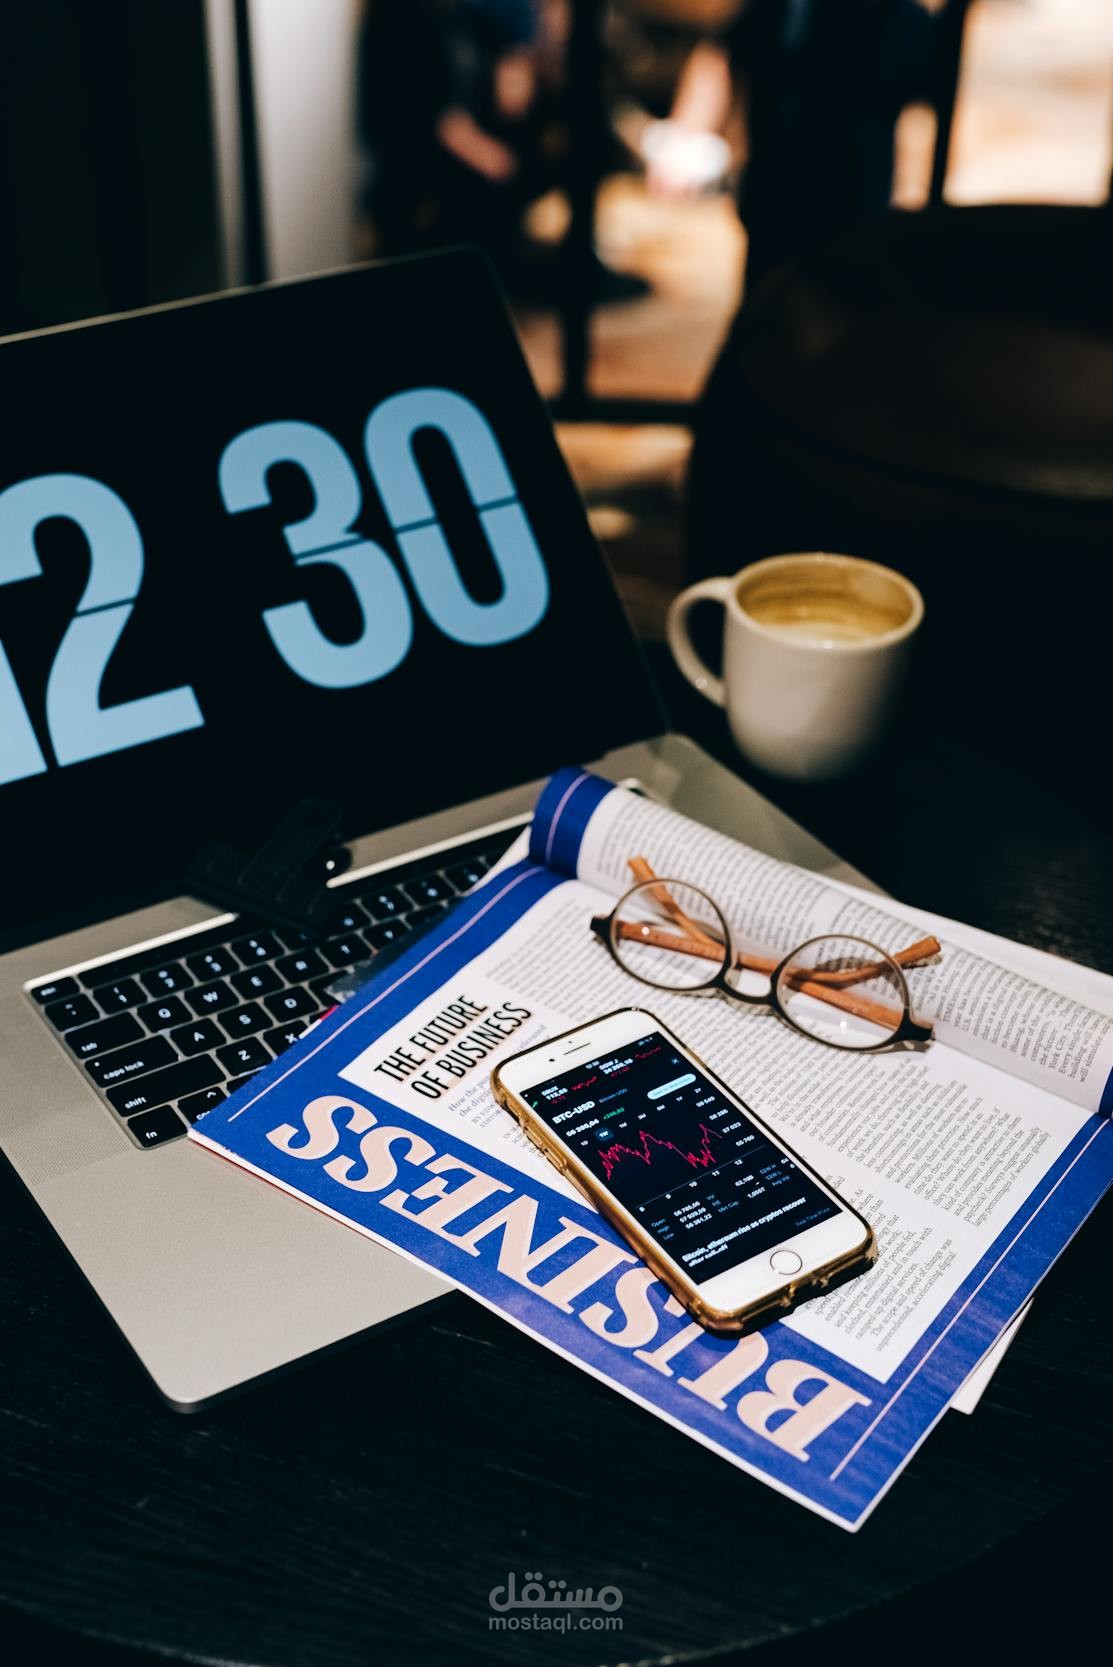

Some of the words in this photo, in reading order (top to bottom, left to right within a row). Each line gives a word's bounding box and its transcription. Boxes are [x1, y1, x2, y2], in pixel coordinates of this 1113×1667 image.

[0, 473, 205, 786] 2
[219, 387, 549, 689] 30
[202, 991, 219, 1004] W
[193, 1031, 205, 1043] A
[238, 1013, 252, 1026] S
[373, 1046, 427, 1082] THE
[408, 995, 489, 1055] FUTURE
[237, 1049, 252, 1062] Z
[284, 1032, 299, 1045] X
[410, 1071, 450, 1099] OF
[435, 1002, 533, 1079] BUSINESS
[1066, 1045, 1087, 1078] building
[103, 1067, 126, 1080] caps
[123, 1059, 145, 1073] lock
[124, 1095, 147, 1110] shift
[447, 1093, 467, 1112] How
[463, 1083, 479, 1098] the
[457, 1103, 472, 1118] the
[550, 1099, 597, 1124] BTC-USD
[145, 1129, 158, 1140] fn
[710, 1169, 721, 1177] 11
[733, 1158, 744, 1166] 12
[680, 1244, 710, 1262] Bitcoin,
[704, 1229, 739, 1250] ethereum
[735, 1223, 752, 1234] rise
[756, 1207, 785, 1225] cryptos
[780, 1196, 808, 1212] recover
[266, 1095, 872, 1462] BUSINESS
